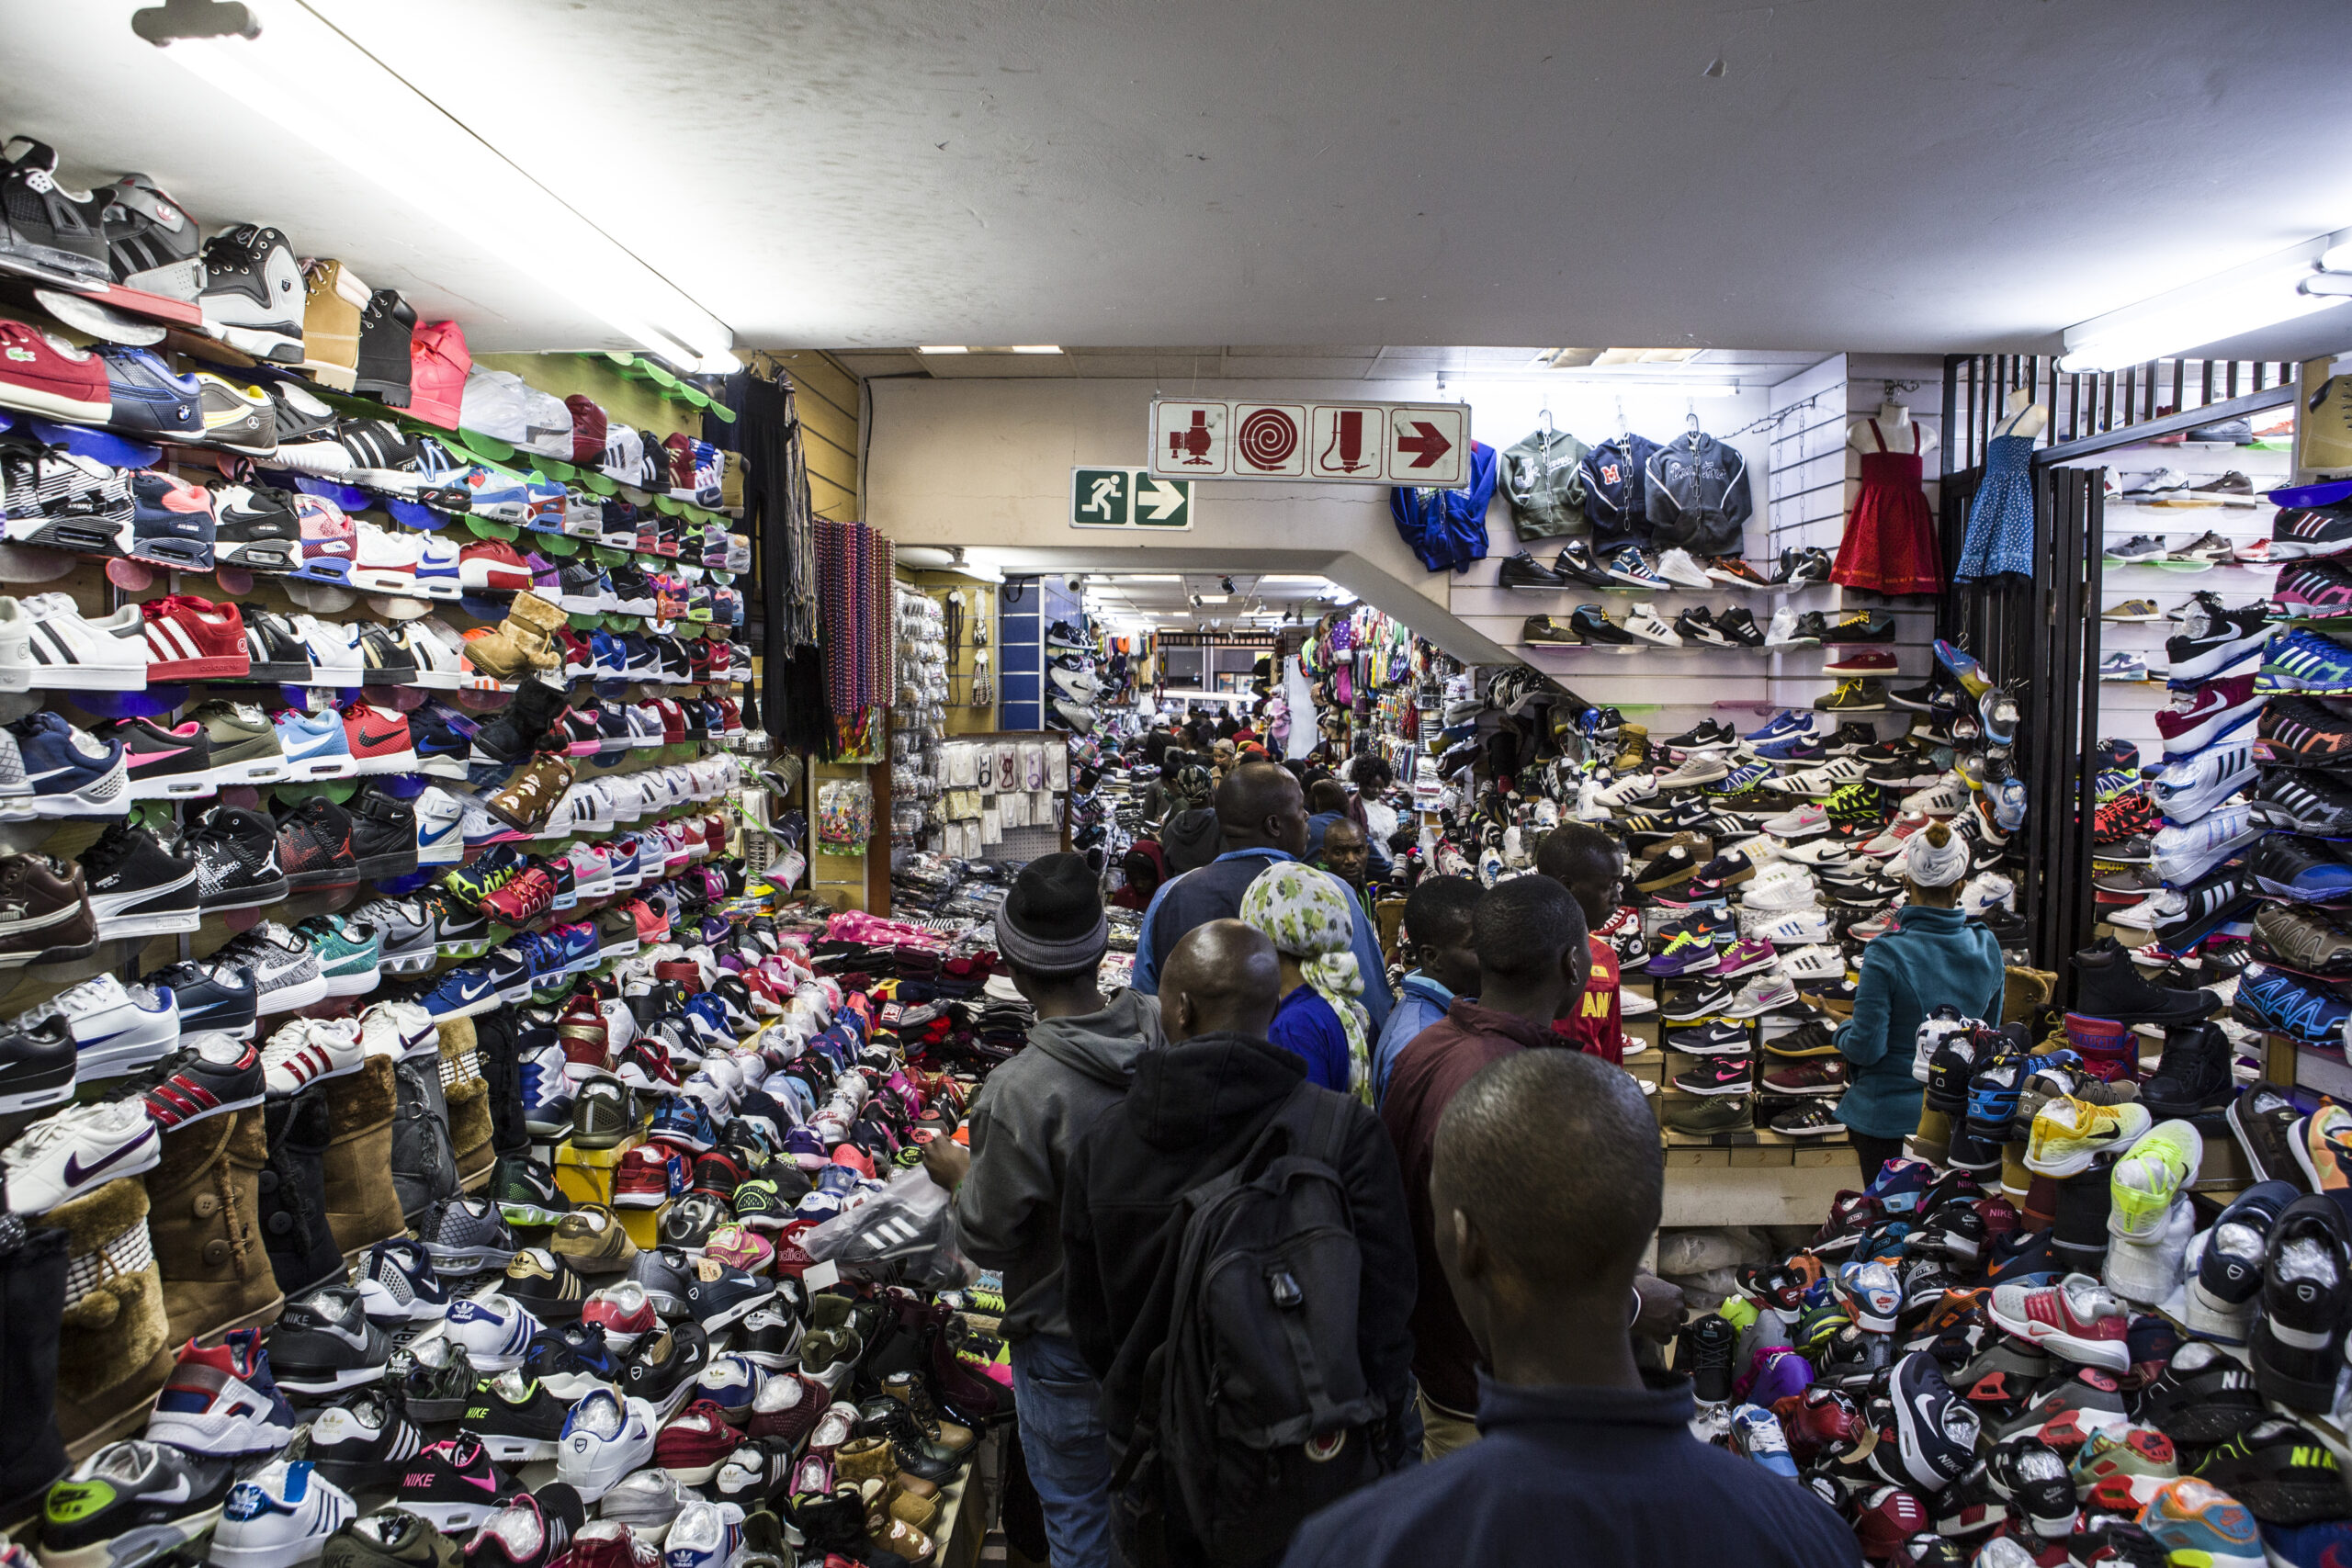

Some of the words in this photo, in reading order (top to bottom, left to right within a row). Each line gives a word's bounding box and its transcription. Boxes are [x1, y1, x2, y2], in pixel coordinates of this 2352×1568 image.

[1601, 464, 1622, 485] M
[788, 1064, 805, 1073] NIKE
[1989, 1208, 2013, 1219] NIKE
[283, 1312, 310, 1326] NIKE
[451, 1313, 472, 1321] adidas
[387, 1366, 407, 1374] adidas
[465, 1407, 490, 1419] NIKE
[1937, 1453, 1964, 1473] NIKE
[402, 1472, 435, 1488] NIKE
[228, 1502, 256, 1514] adidas
[323, 1553, 355, 1568] NIKE
